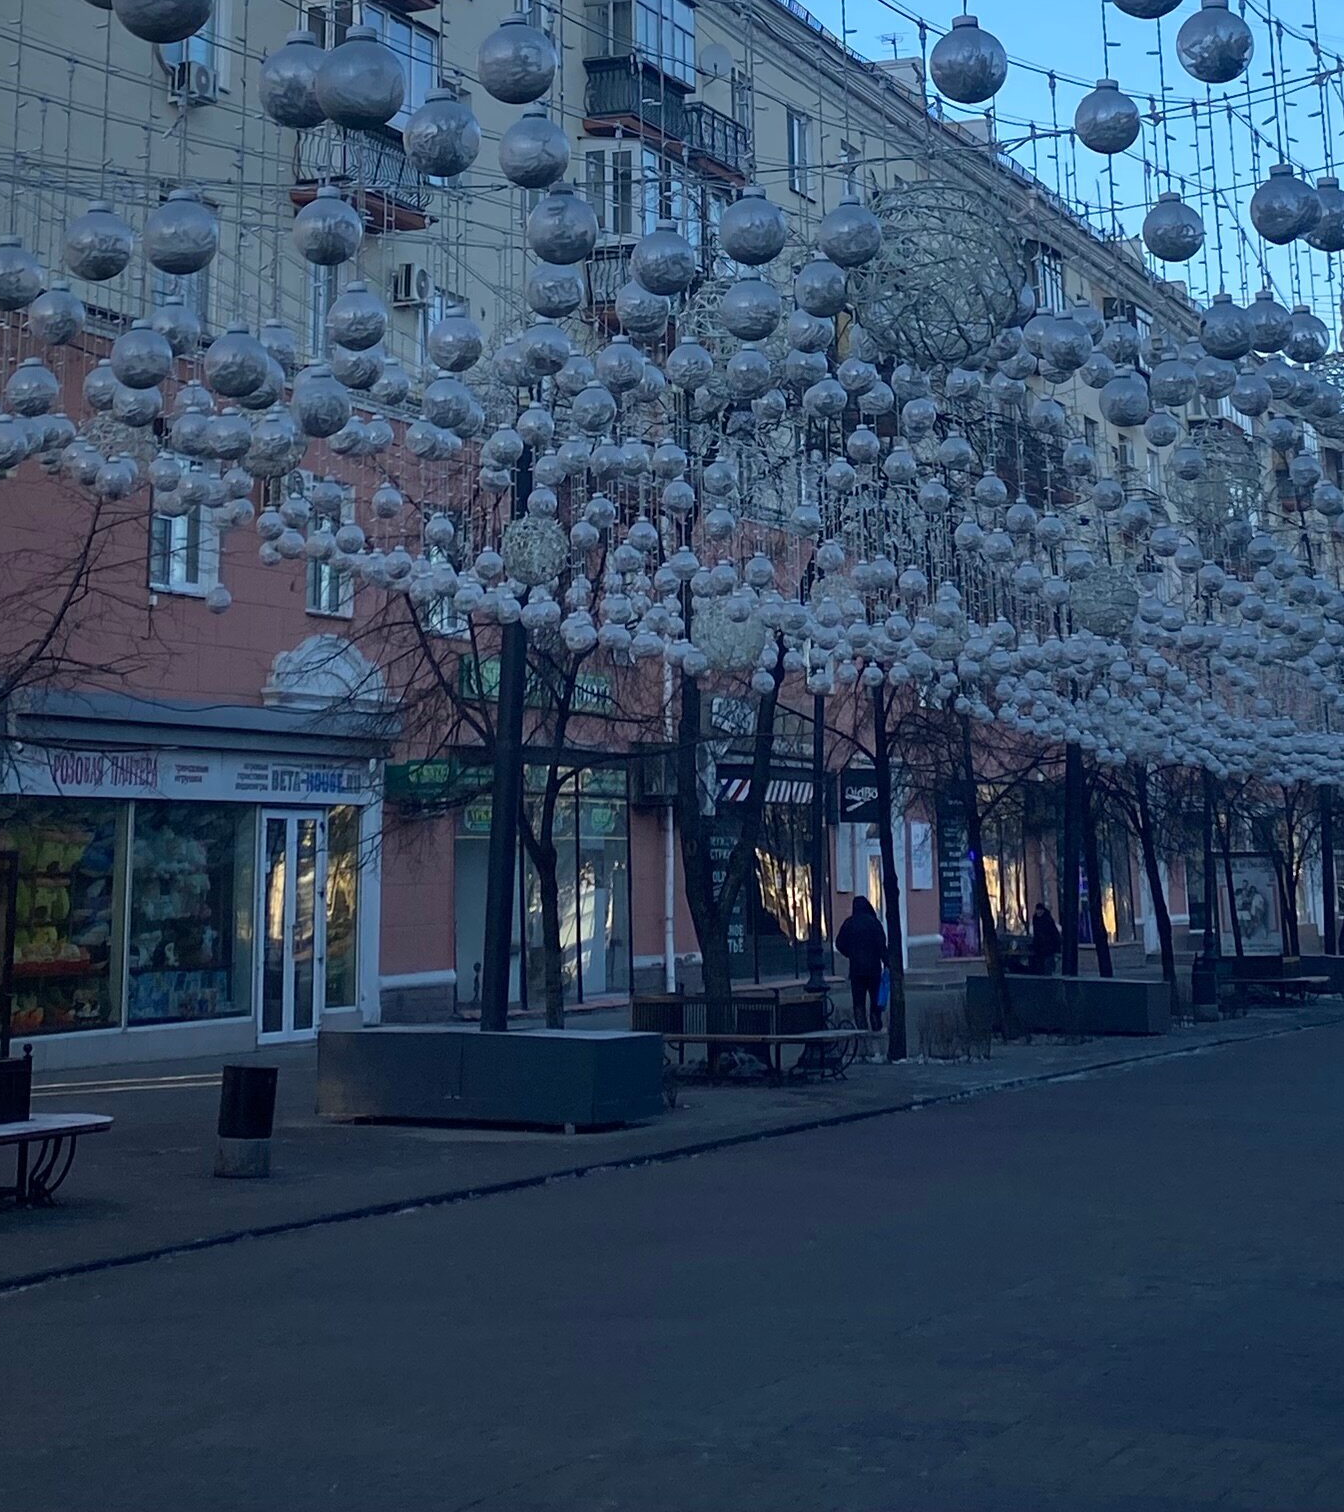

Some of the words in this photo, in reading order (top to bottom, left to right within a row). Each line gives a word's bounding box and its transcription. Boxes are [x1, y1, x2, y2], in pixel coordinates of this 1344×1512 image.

[53, 752, 104, 786] РОЗОВАЯ
[110, 755, 158, 788] ПАНТЕРА
[845, 786, 878, 800] OldBo
